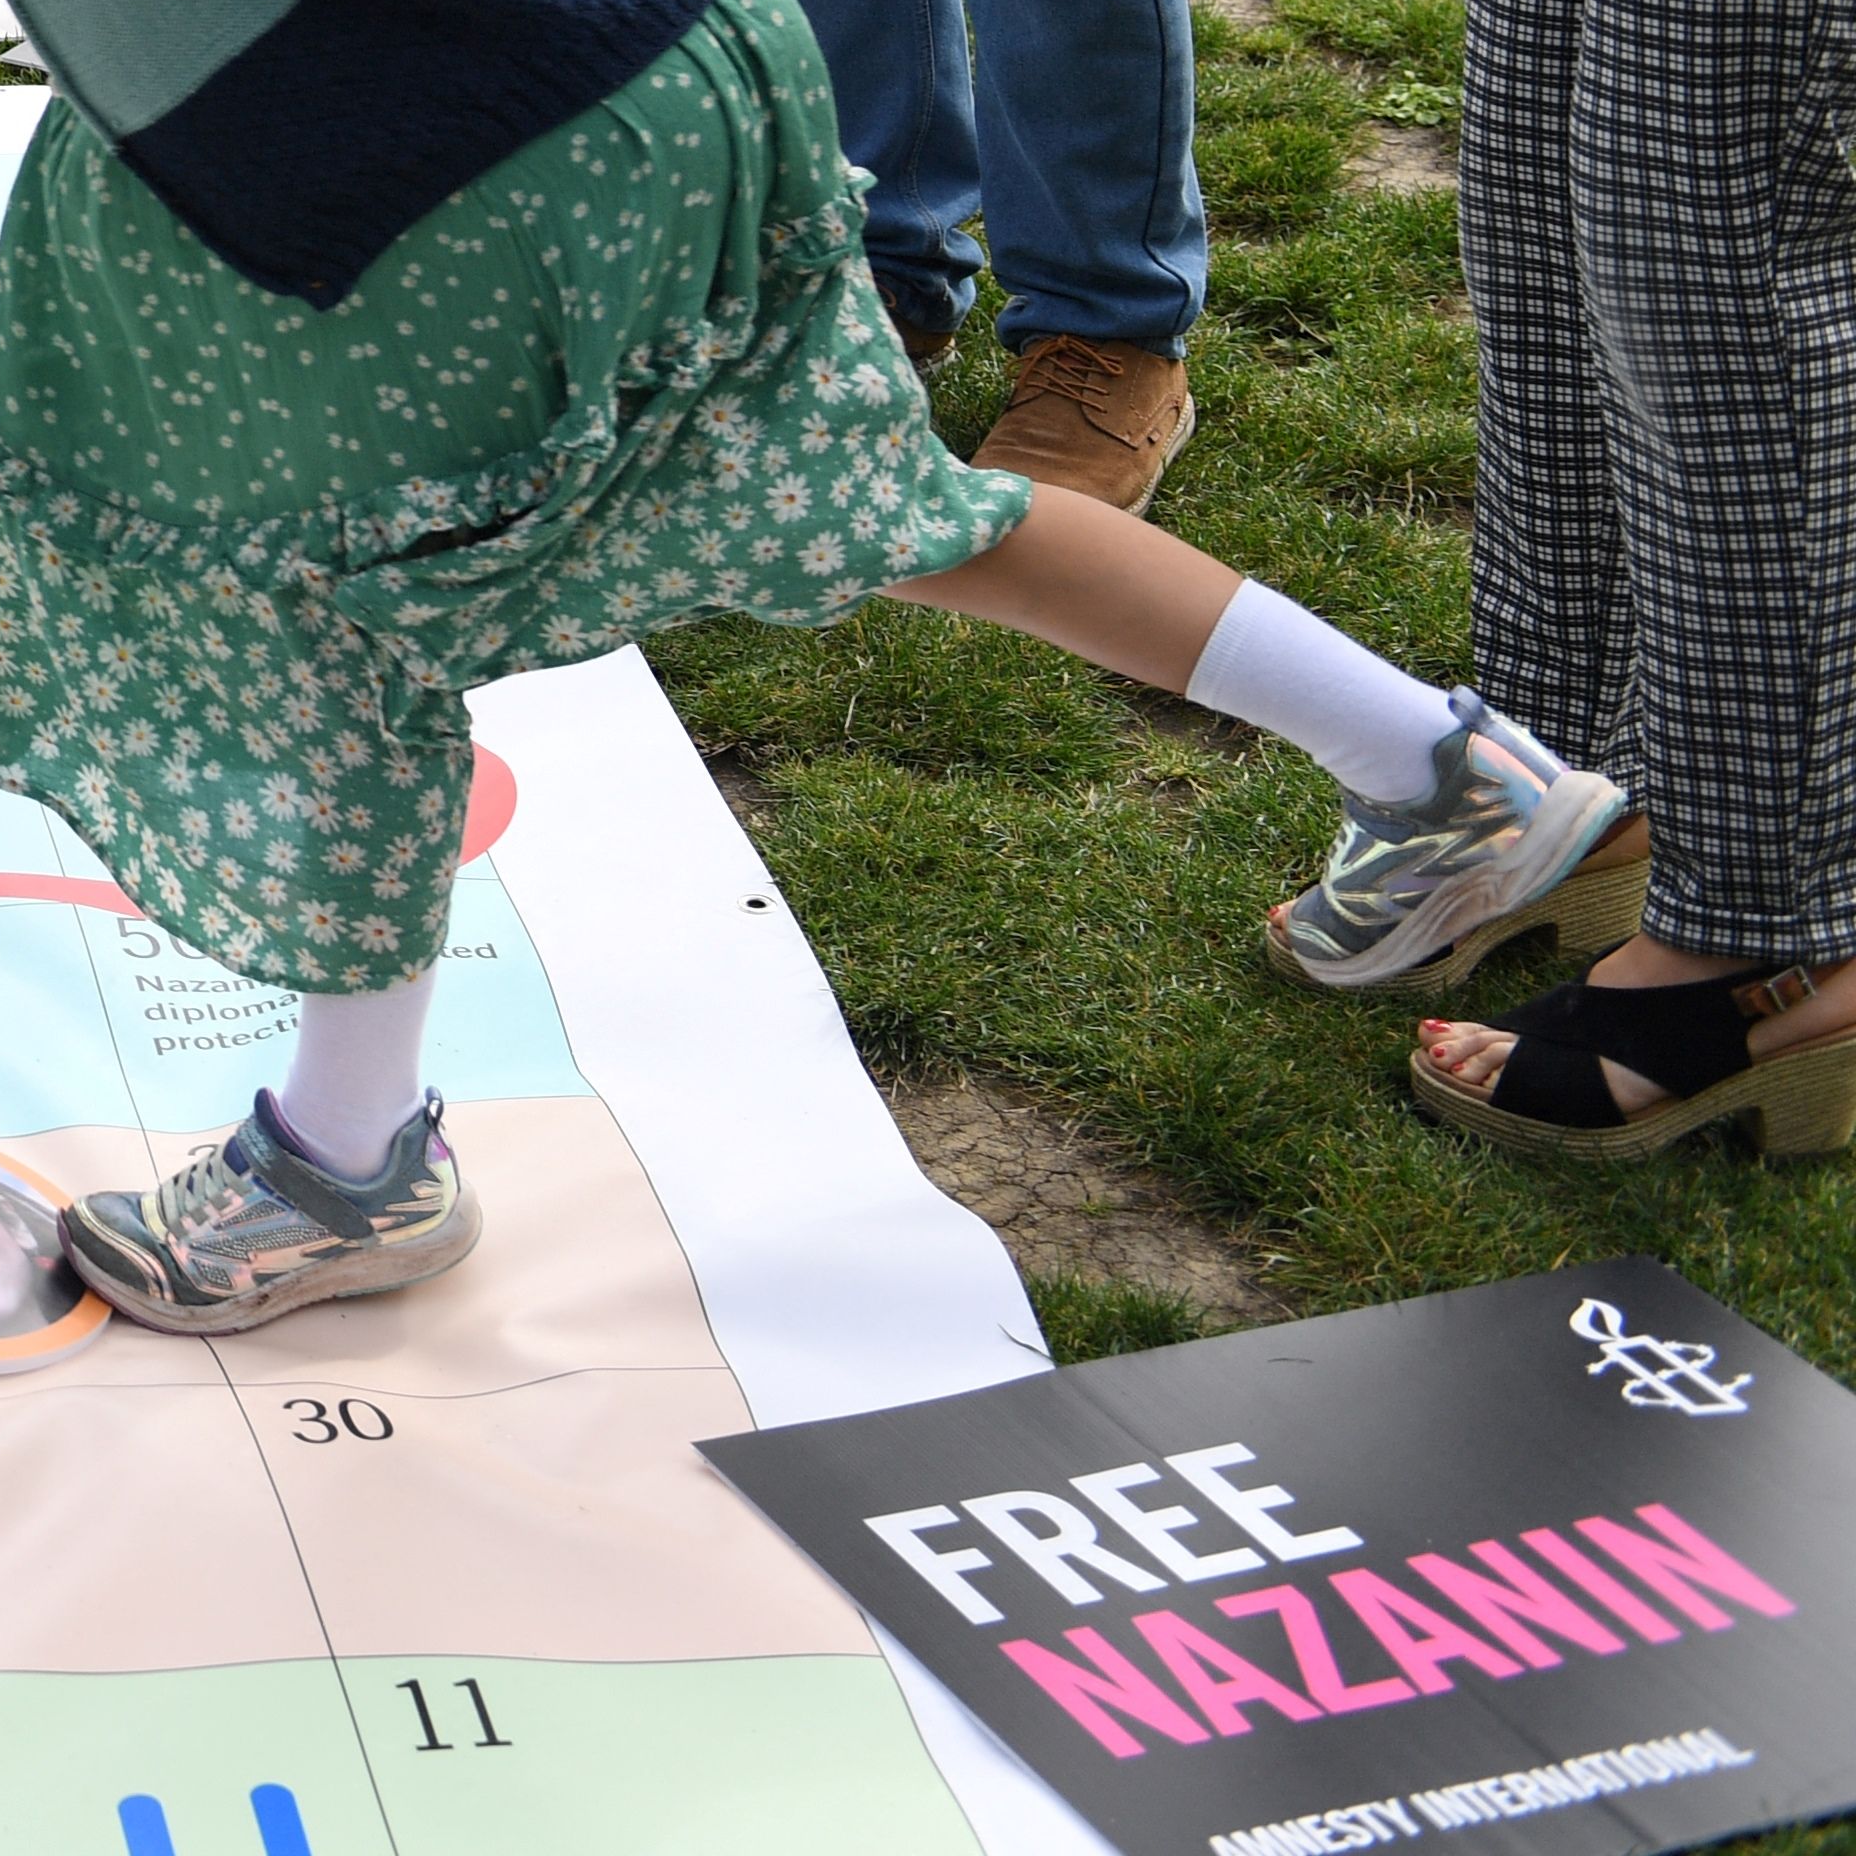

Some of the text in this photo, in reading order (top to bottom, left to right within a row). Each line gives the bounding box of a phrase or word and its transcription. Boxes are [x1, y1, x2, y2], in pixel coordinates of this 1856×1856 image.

[282, 1399, 394, 1444] 30
[864, 1443, 1365, 1626] FREE
[998, 1503, 1797, 1759] NAZANIN
[396, 1677, 513, 1751] 11
[1409, 1727, 1755, 1834] INTERNATIONAL
